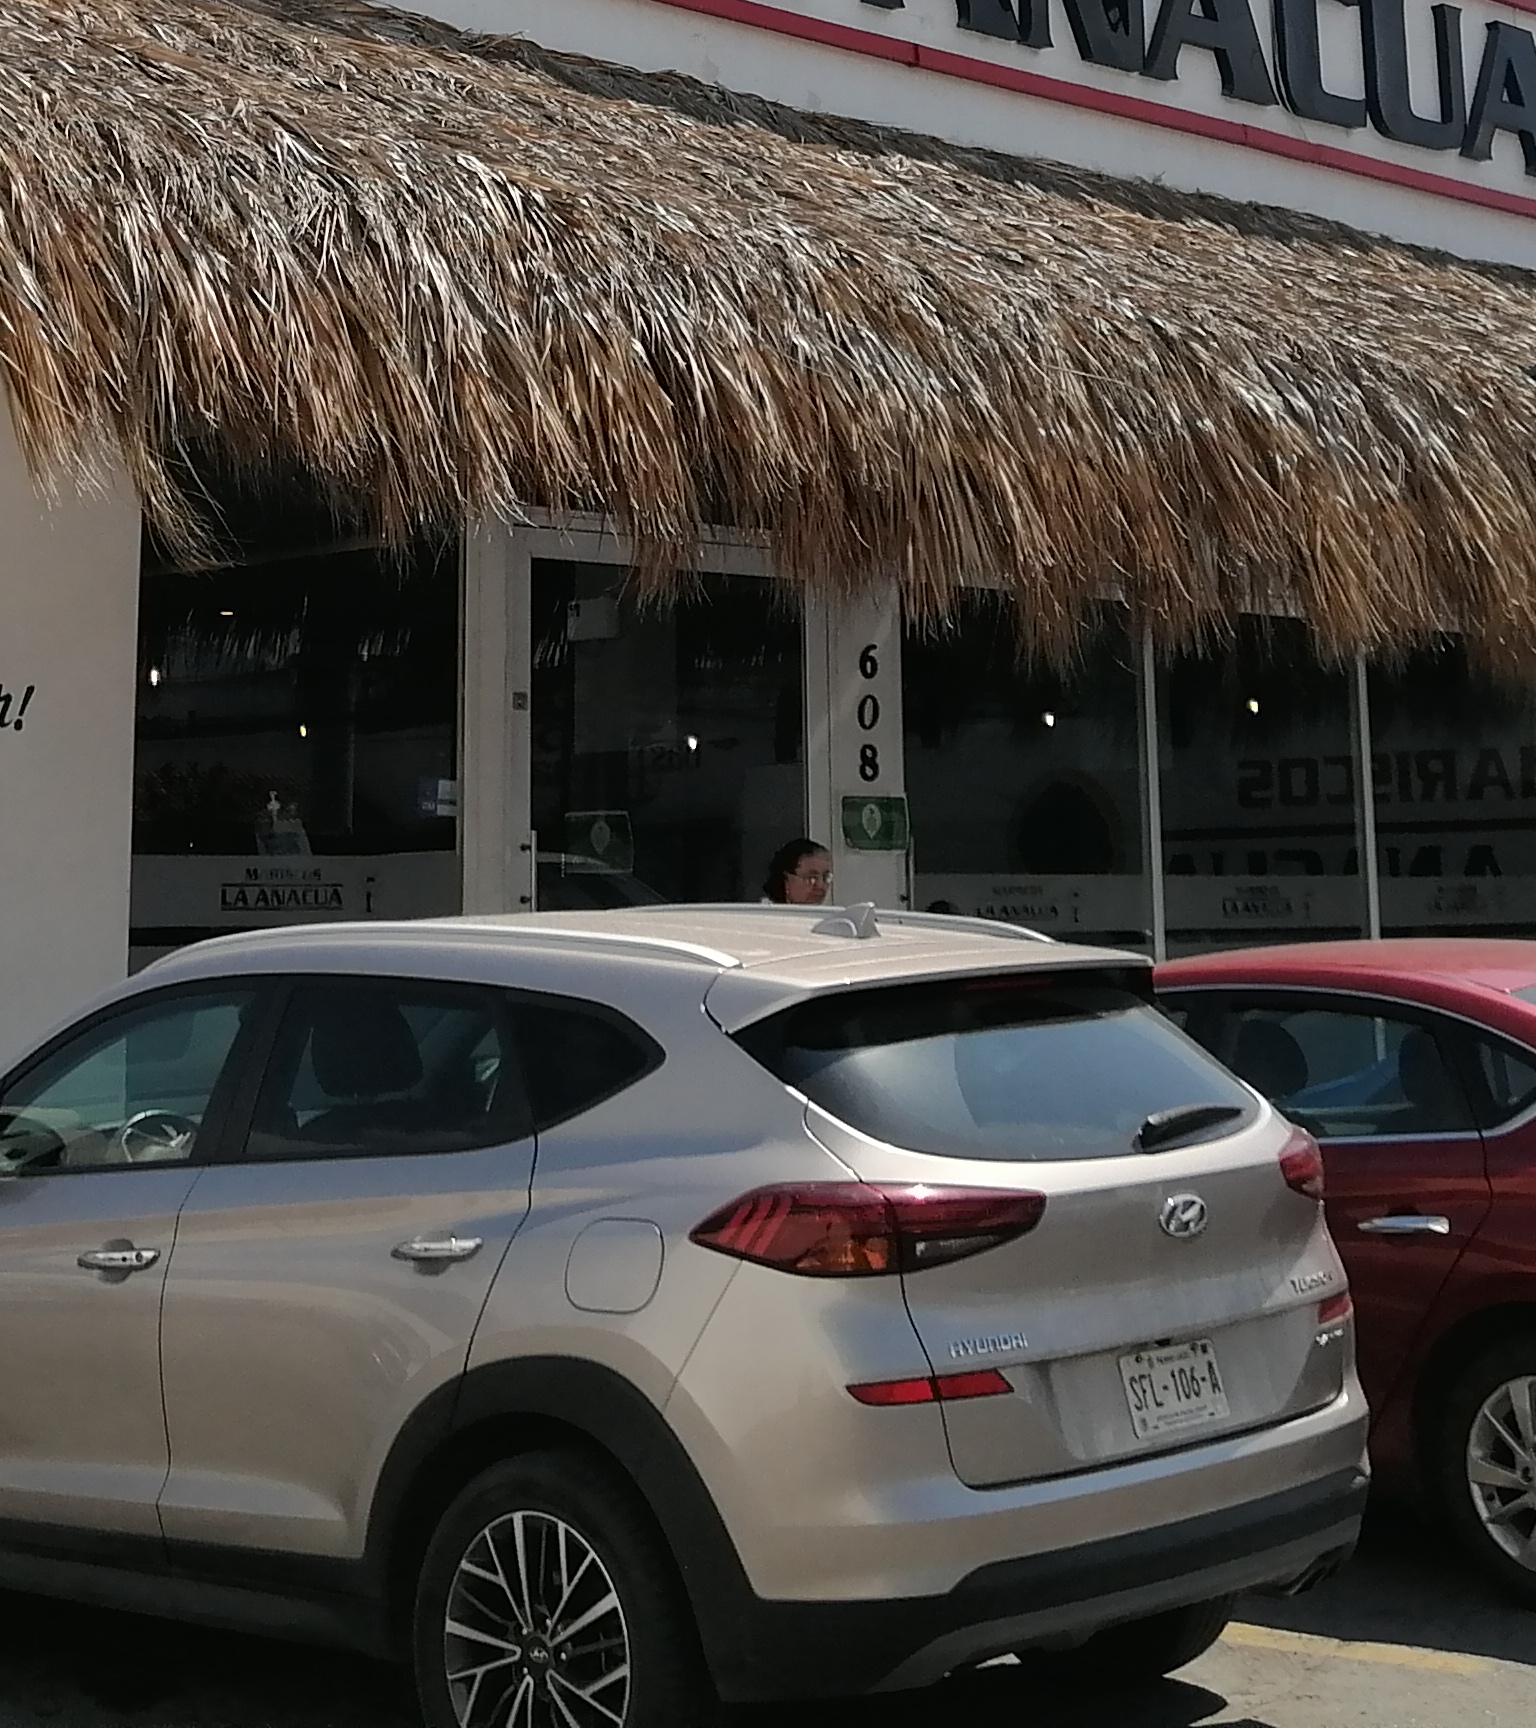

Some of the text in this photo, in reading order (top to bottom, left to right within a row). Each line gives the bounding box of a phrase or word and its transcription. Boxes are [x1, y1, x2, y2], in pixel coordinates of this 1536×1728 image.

[857, 644, 880, 782] 608
[245, 868, 321, 881] MRISOS
[221, 888, 248, 906] LA
[948, 1332, 1028, 1359] HYUNDAI
[1129, 1360, 1222, 1412] SFL-106-A
